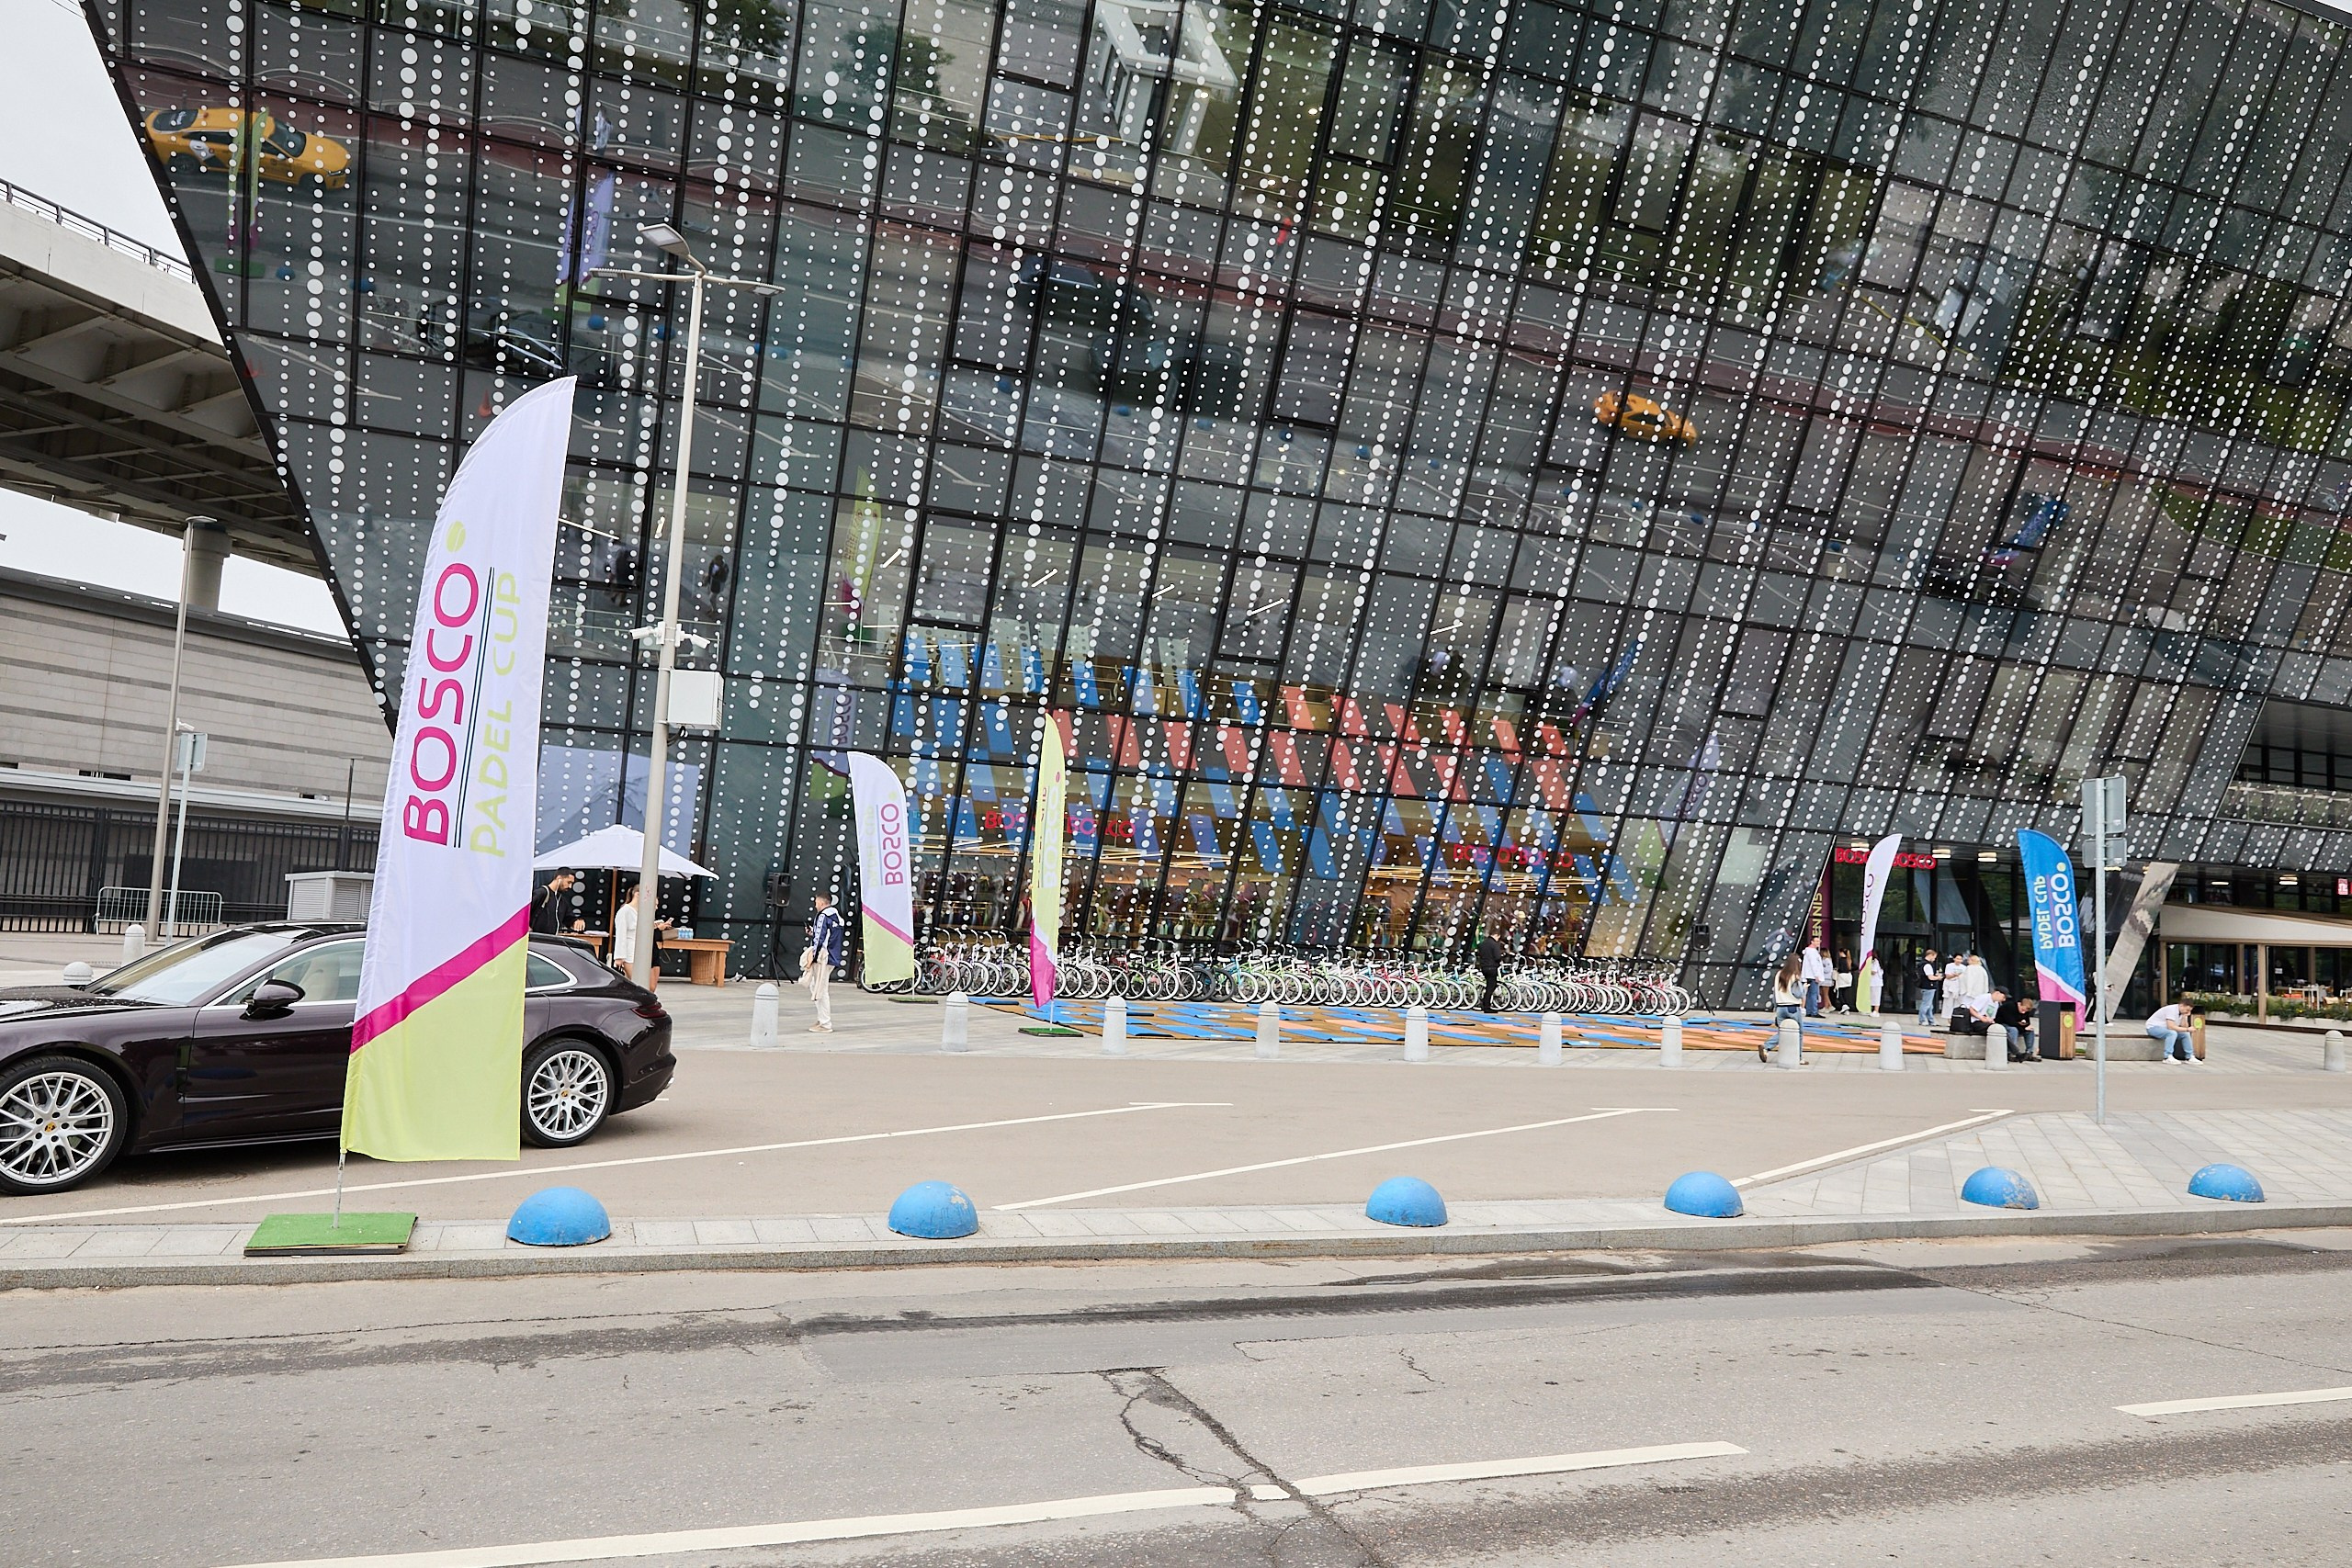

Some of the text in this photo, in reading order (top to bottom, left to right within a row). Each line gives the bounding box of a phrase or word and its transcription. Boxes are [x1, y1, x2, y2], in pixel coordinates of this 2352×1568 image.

[402, 562, 479, 846] BOSCO
[469, 571, 520, 859] PADEL CUP
[985, 810, 1136, 838] BOS BOCO
[1453, 844, 1510, 863] BOSO
[1835, 847, 1871, 864] BOSC
[1812, 892, 1823, 937] ENNIS
